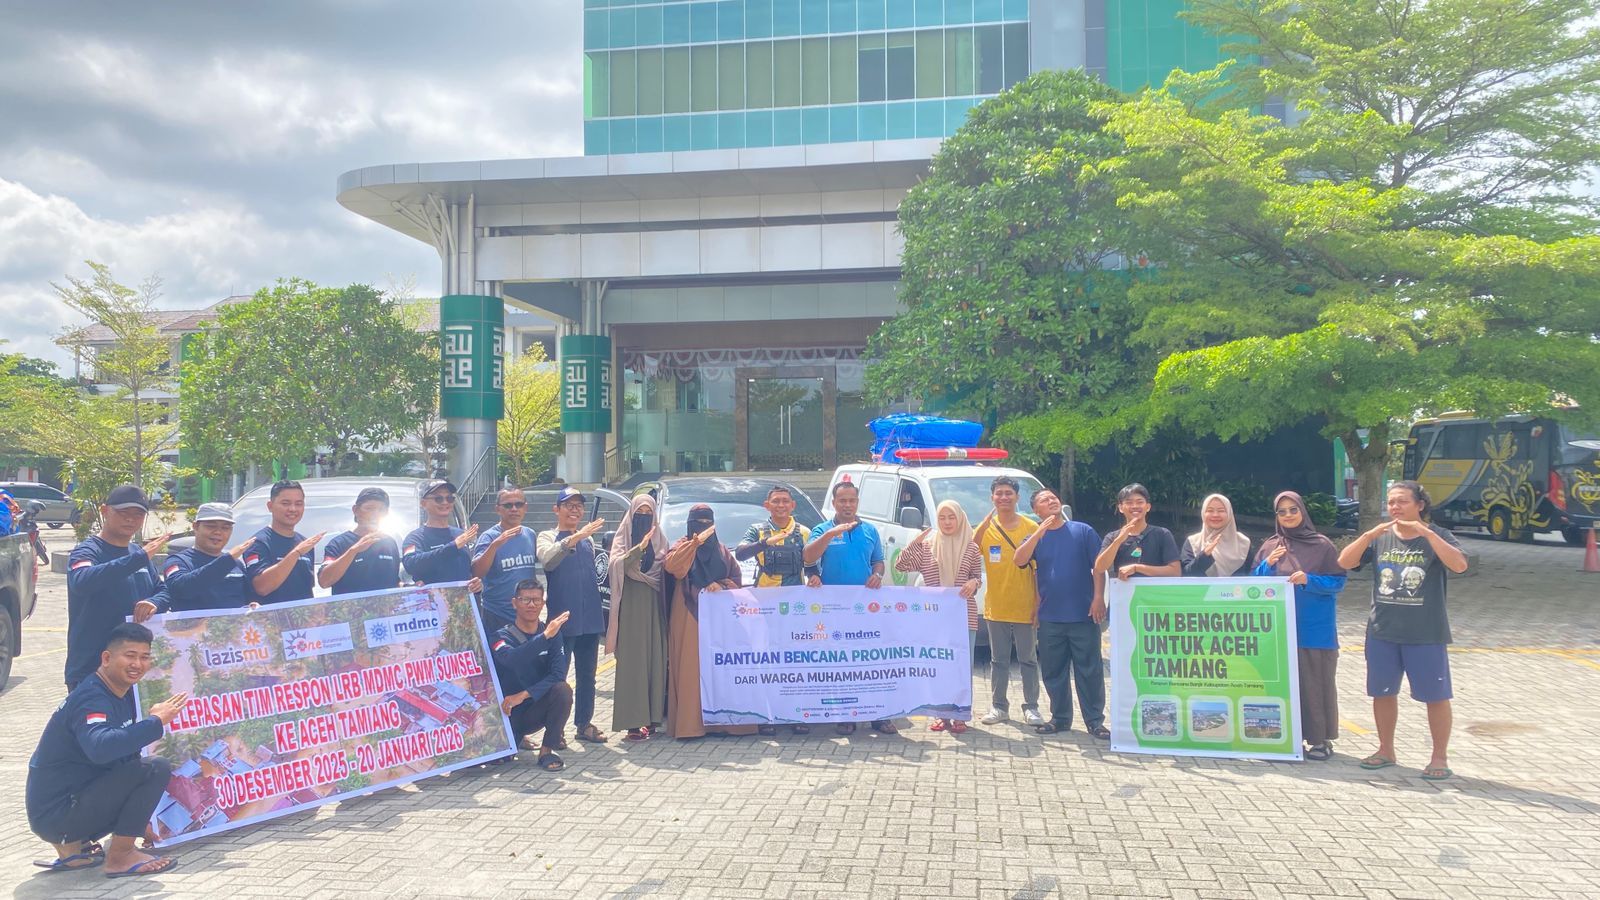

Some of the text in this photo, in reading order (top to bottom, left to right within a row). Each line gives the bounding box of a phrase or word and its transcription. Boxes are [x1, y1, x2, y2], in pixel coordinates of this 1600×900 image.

[501, 554, 535, 568] mdm
[394, 618, 438, 633] mdmc
[1143, 612, 1272, 633] UM BENGKULU
[791, 631, 828, 640] lazismu
[845, 630, 880, 639] mdmc
[1144, 635, 1258, 656] UNTUK ACEH
[205, 647, 269, 666] lazismu
[714, 646, 954, 665] BANTUAN BENCANA PROVINSI ACEH
[734, 667, 936, 684] DARI WARGA MUHAMMADIYAH RIAU
[1144, 657, 1227, 679] TAMIANG
[168, 651, 481, 732] LEPASAN TIM RESPON LRB MDMC PWM SUMSEL
[275, 702, 400, 753] KE ACEH TAMIANG
[215, 775, 235, 808] 30
[235, 760, 313, 805] DESEMBER
[314, 751, 347, 783] 2025
[357, 744, 375, 775] 20
[377, 730, 433, 769] JANUARI
[432, 724, 463, 754] 2026
